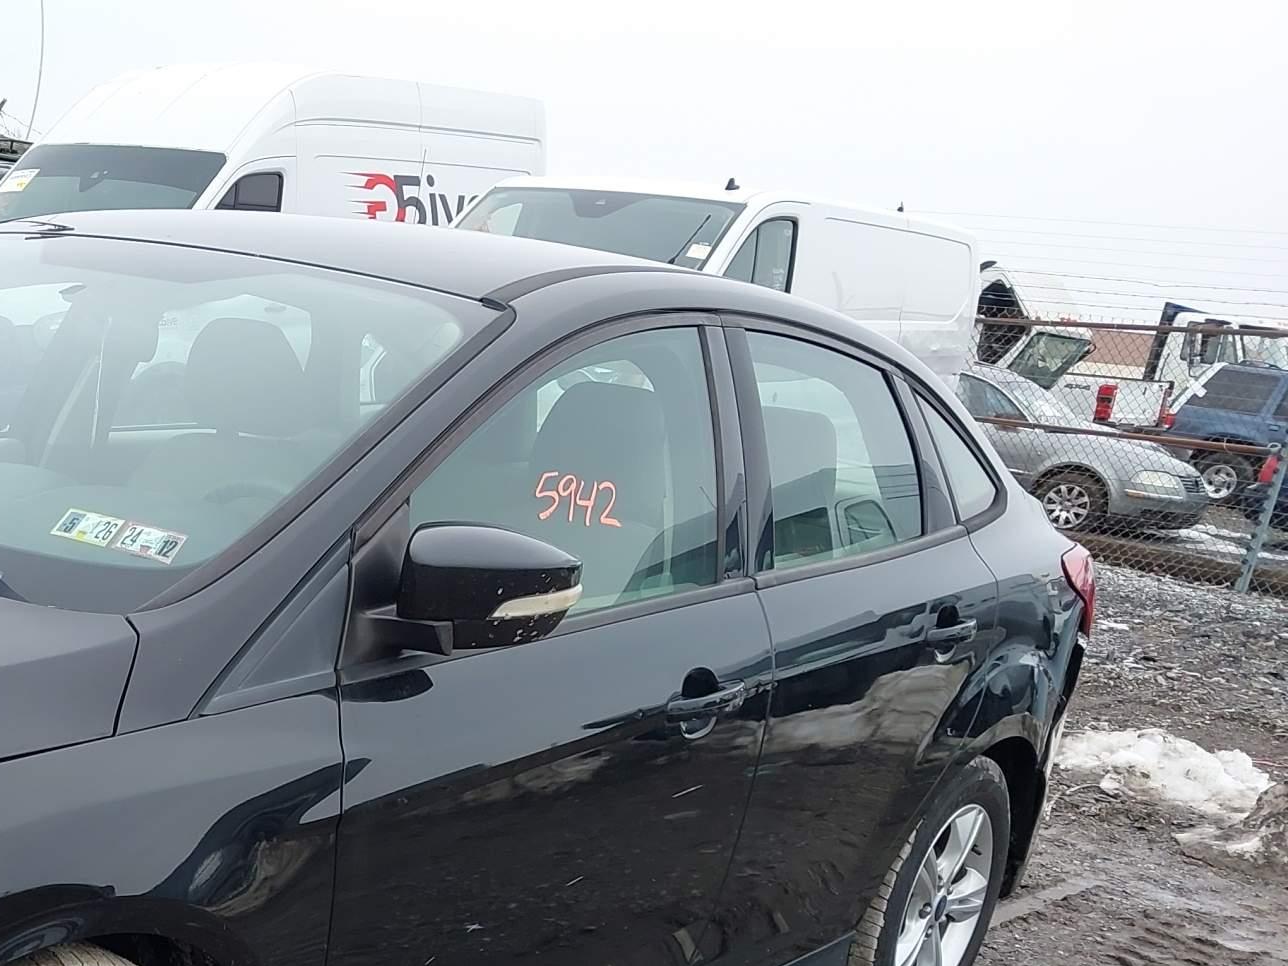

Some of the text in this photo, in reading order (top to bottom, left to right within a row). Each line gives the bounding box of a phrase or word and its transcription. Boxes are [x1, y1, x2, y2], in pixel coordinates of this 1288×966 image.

[535, 471, 623, 528] 5942
[94, 521, 119, 541] 26
[119, 526, 179, 559] 24 12
